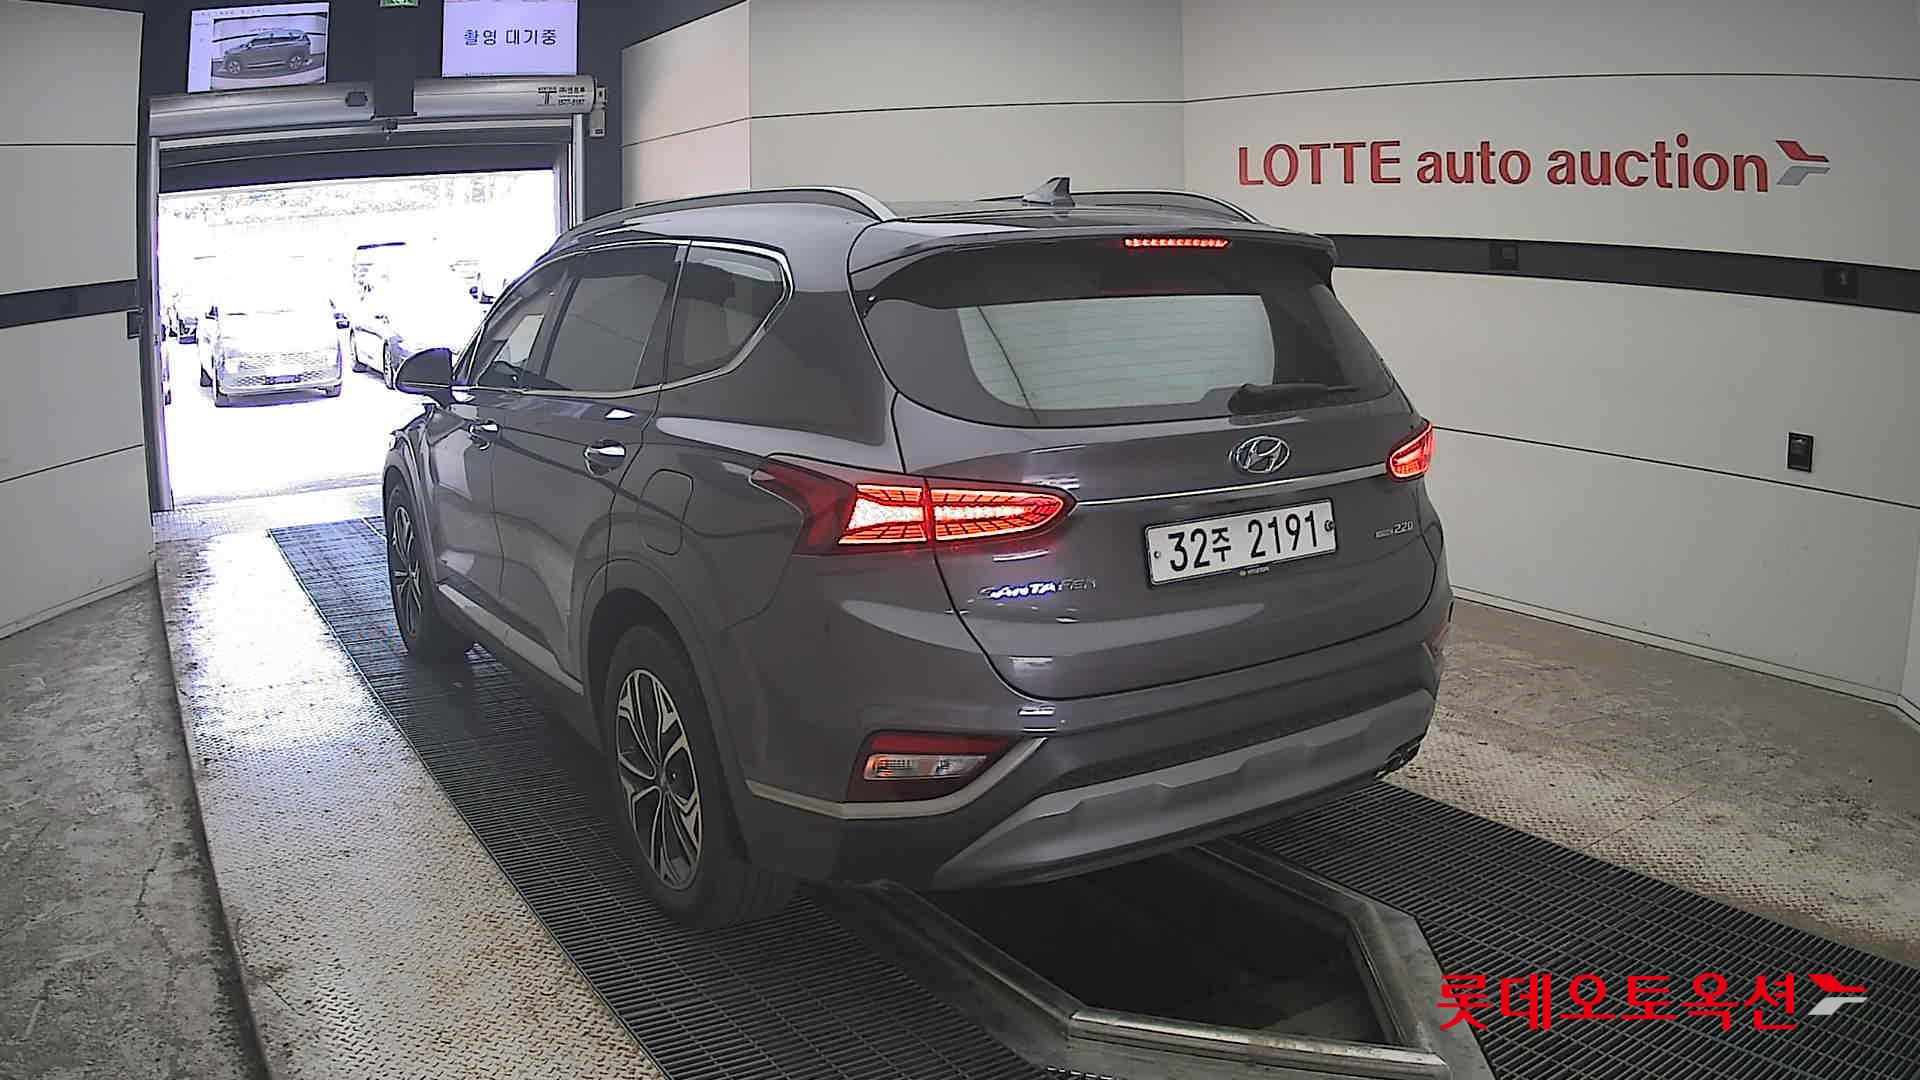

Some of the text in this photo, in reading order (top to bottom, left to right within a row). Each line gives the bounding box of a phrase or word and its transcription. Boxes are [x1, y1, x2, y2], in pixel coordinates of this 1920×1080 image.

[464, 29, 556, 46] 촬영 대기중
[1238, 133, 1769, 192] LOTTE auto auction
[1168, 510, 1318, 572] 32주 2191
